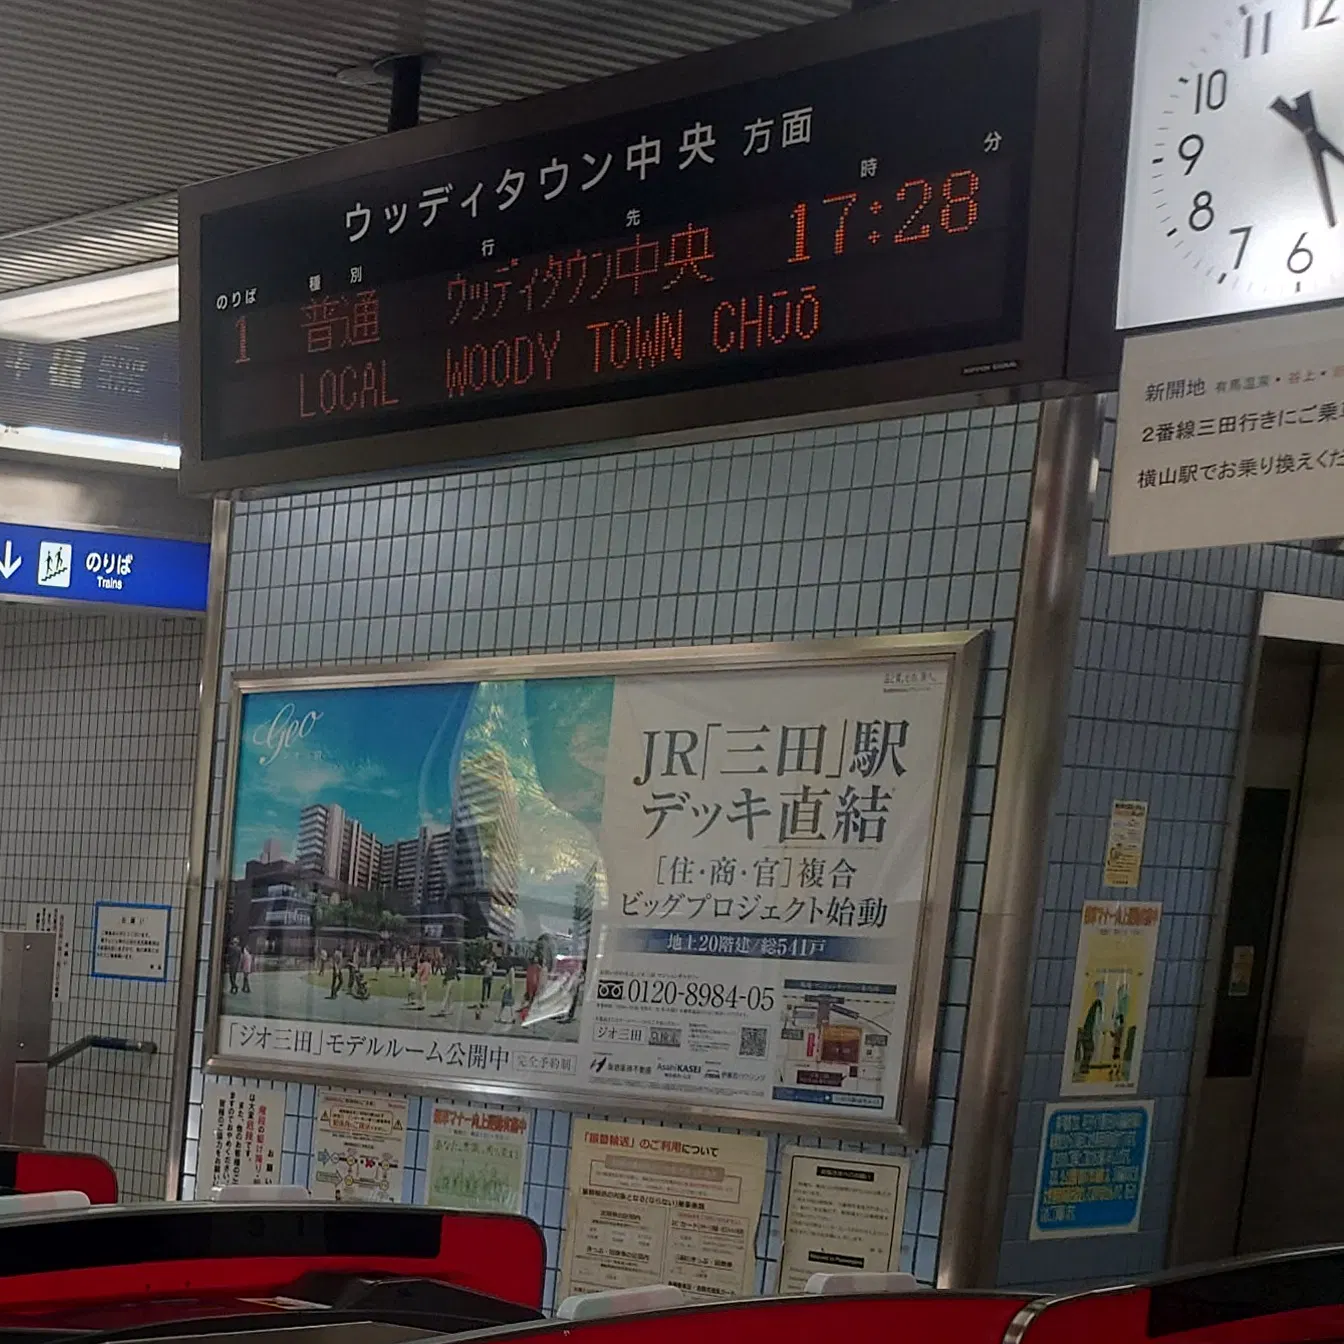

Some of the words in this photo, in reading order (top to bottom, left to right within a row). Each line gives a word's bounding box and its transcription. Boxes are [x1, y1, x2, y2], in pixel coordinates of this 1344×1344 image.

[1243, 9, 1272, 59] 11
[1195, 69, 1228, 114] 10
[982, 131, 1003, 153] 分
[1178, 134, 1204, 175] 9
[344, 121, 717, 243] ウッディタウン中央
[742, 106, 814, 157] 方面
[859, 158, 879, 179] 時
[1189, 190, 1216, 232] 8
[233, 315, 252, 364] 1
[299, 289, 382, 354] 普通
[445, 222, 716, 325] ウッディタウン中央
[787, 168, 980, 264] 17:28
[1229, 227, 1253, 270] 7
[1287, 232, 1314, 274] 6
[215, 287, 258, 311] のりば
[299, 359, 399, 419] LOCAL
[445, 329, 561, 398] WOODY
[586, 308, 684, 373] TOWN
[1144, 377, 1206, 403] 新開地
[1141, 400, 1344, 443] 2番線三田行きにご乗
[85, 552, 134, 576] のりば
[96, 575, 123, 590] Trains
[252, 702, 324, 767] Geo
[632, 718, 911, 787] JR「三田」駅
[642, 784, 893, 845] デッキ直結
[620, 890, 889, 929] ビッグプロジェクト始動
[627, 978, 775, 1013] 0120-8984-05
[228, 1022, 510, 1072] 「ジオ三田」モデルルーム公開中
